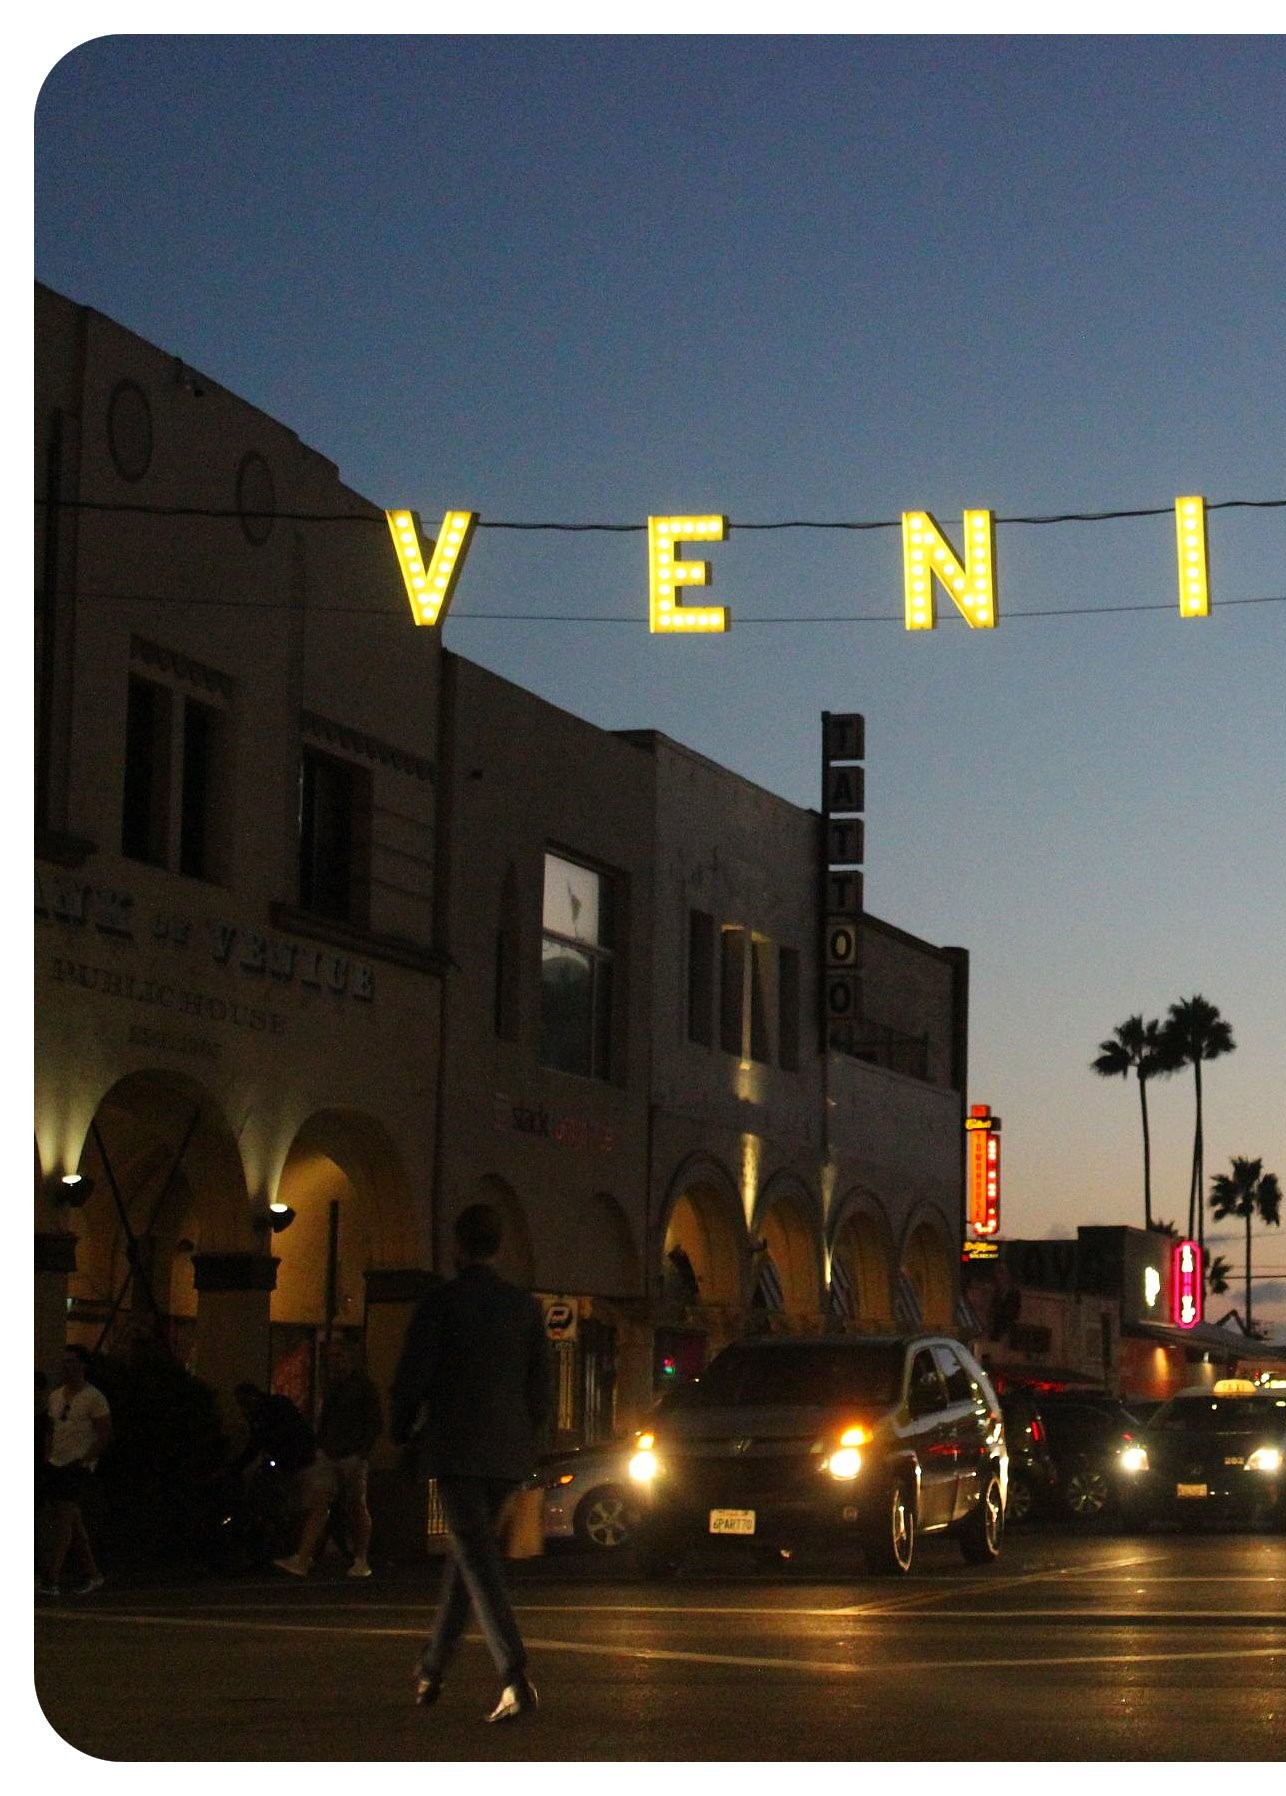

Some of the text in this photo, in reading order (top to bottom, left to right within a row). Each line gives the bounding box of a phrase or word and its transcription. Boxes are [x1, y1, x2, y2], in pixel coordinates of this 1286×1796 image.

[829, 720, 853, 1015] TATTOO
[50, 957, 289, 1036] PUBLIC HOUSE
[211, 917, 377, 1004] VENICE
